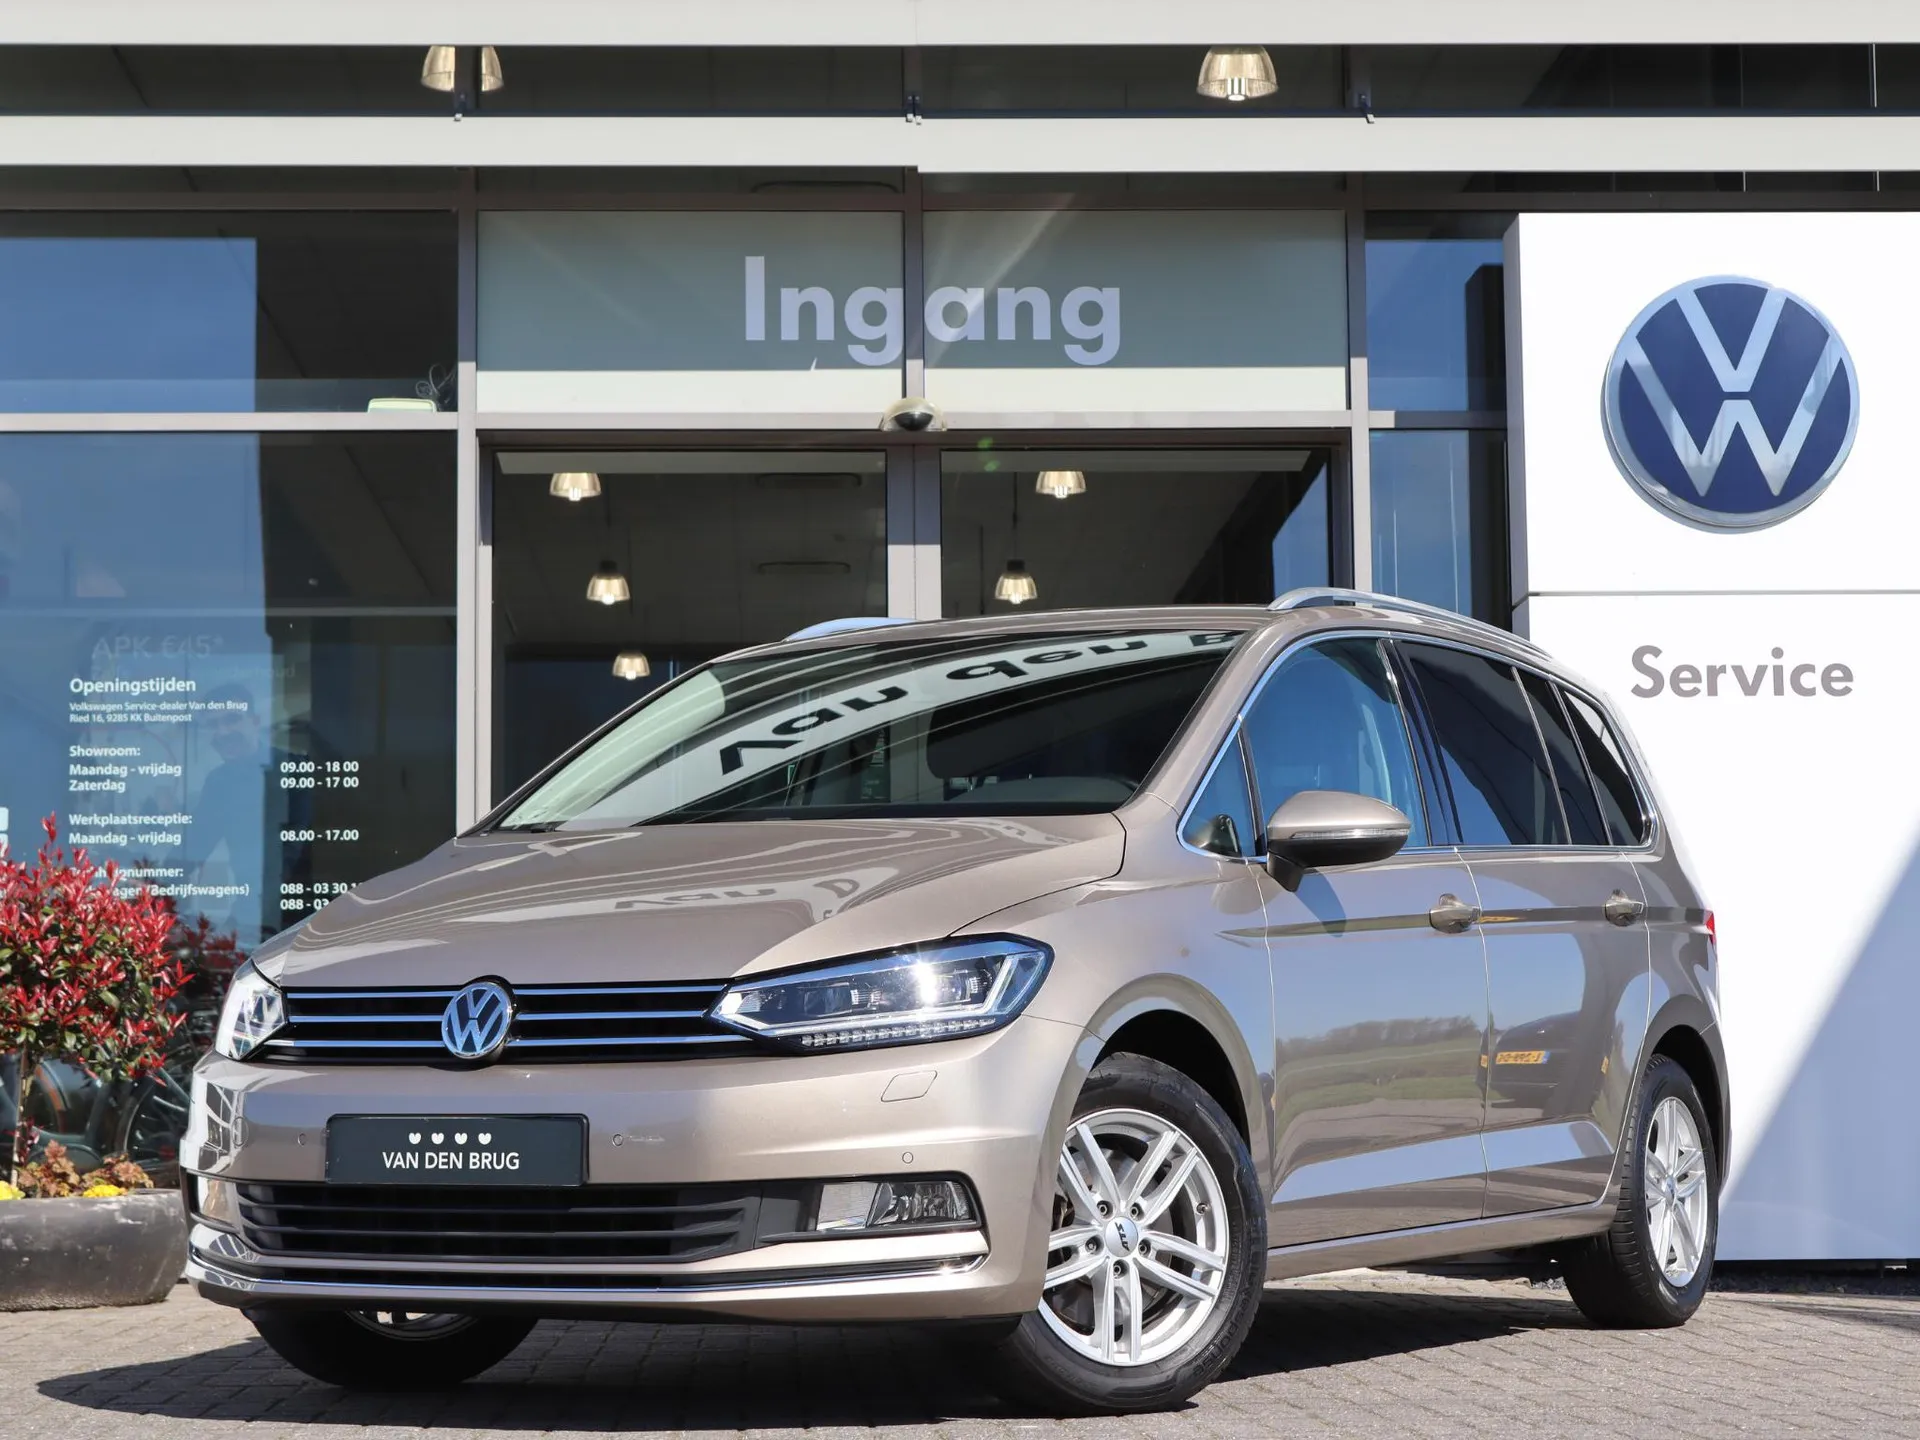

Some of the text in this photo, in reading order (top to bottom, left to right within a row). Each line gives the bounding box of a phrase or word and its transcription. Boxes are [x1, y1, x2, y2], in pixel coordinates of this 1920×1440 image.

[1630, 644, 1854, 699] Service
[69, 677, 196, 696] Openingstijden
[69, 701, 248, 712] Volkswagen Service-dealer Van den Brug
[69, 712, 192, 724] Ried 16, 9285 KK Buitenpost
[69, 745, 141, 757] Showroom:
[69, 764, 128, 778] Maandag
[138, 763, 182, 777] vrijdag
[280, 761, 315, 773] 09.00
[69, 779, 126, 793] Zaterdag
[280, 777, 315, 789] 09.00
[68, 813, 193, 828] Werkplaatsreceptie:
[68, 832, 128, 846] Maandag
[138, 831, 182, 845] vrijdag
[280, 829, 315, 841] 08.00
[325, 829, 359, 841] 17.00
[280, 882, 304, 894] 088
[313, 882, 329, 894] 03
[332, 882, 348, 894] 30
[280, 898, 304, 910] 088
[382, 1151, 520, 1170] VAN DEN BRUG
